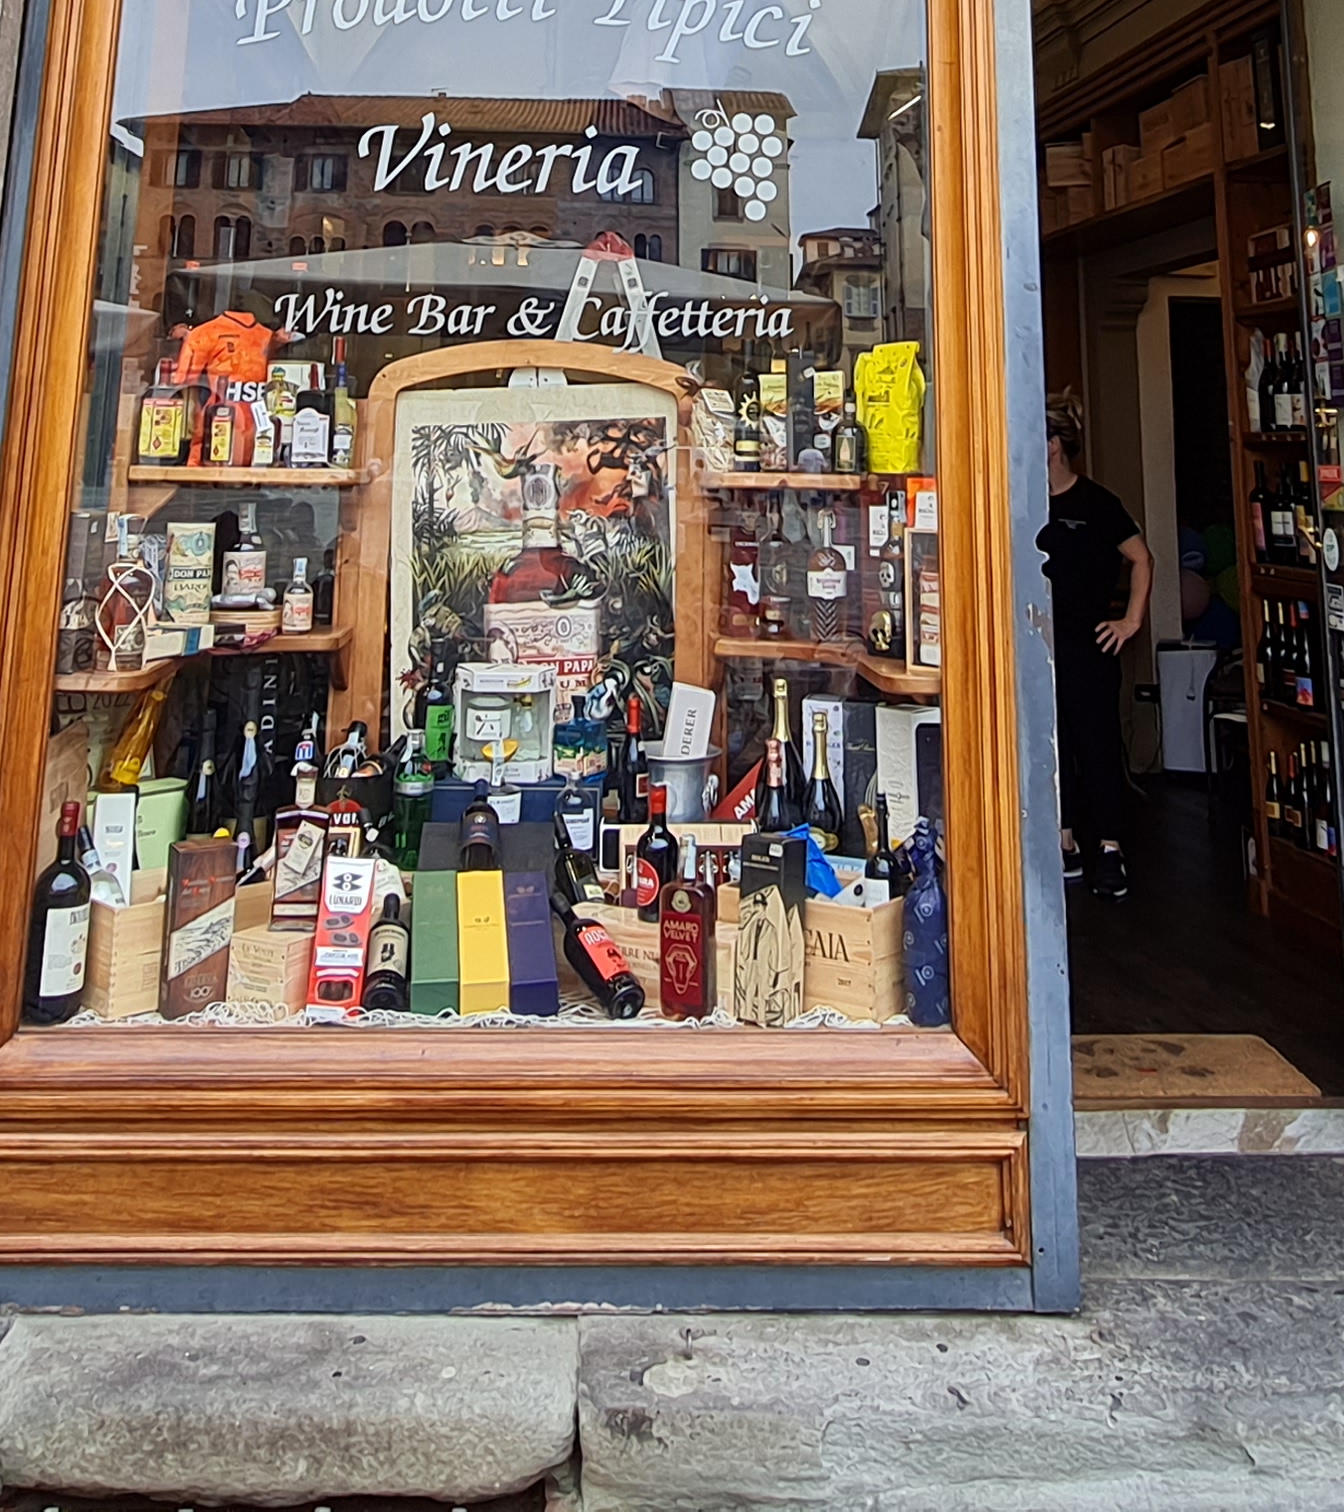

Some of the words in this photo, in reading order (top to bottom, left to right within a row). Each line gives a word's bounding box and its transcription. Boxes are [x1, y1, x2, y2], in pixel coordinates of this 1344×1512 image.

[357, 111, 644, 195] Vineria
[273, 287, 394, 336] Wine
[407, 293, 496, 336] Bar
[506, 296, 556, 336] &
[572, 289, 795, 354] Caffetteria
[663, 919, 699, 933] AMARO
